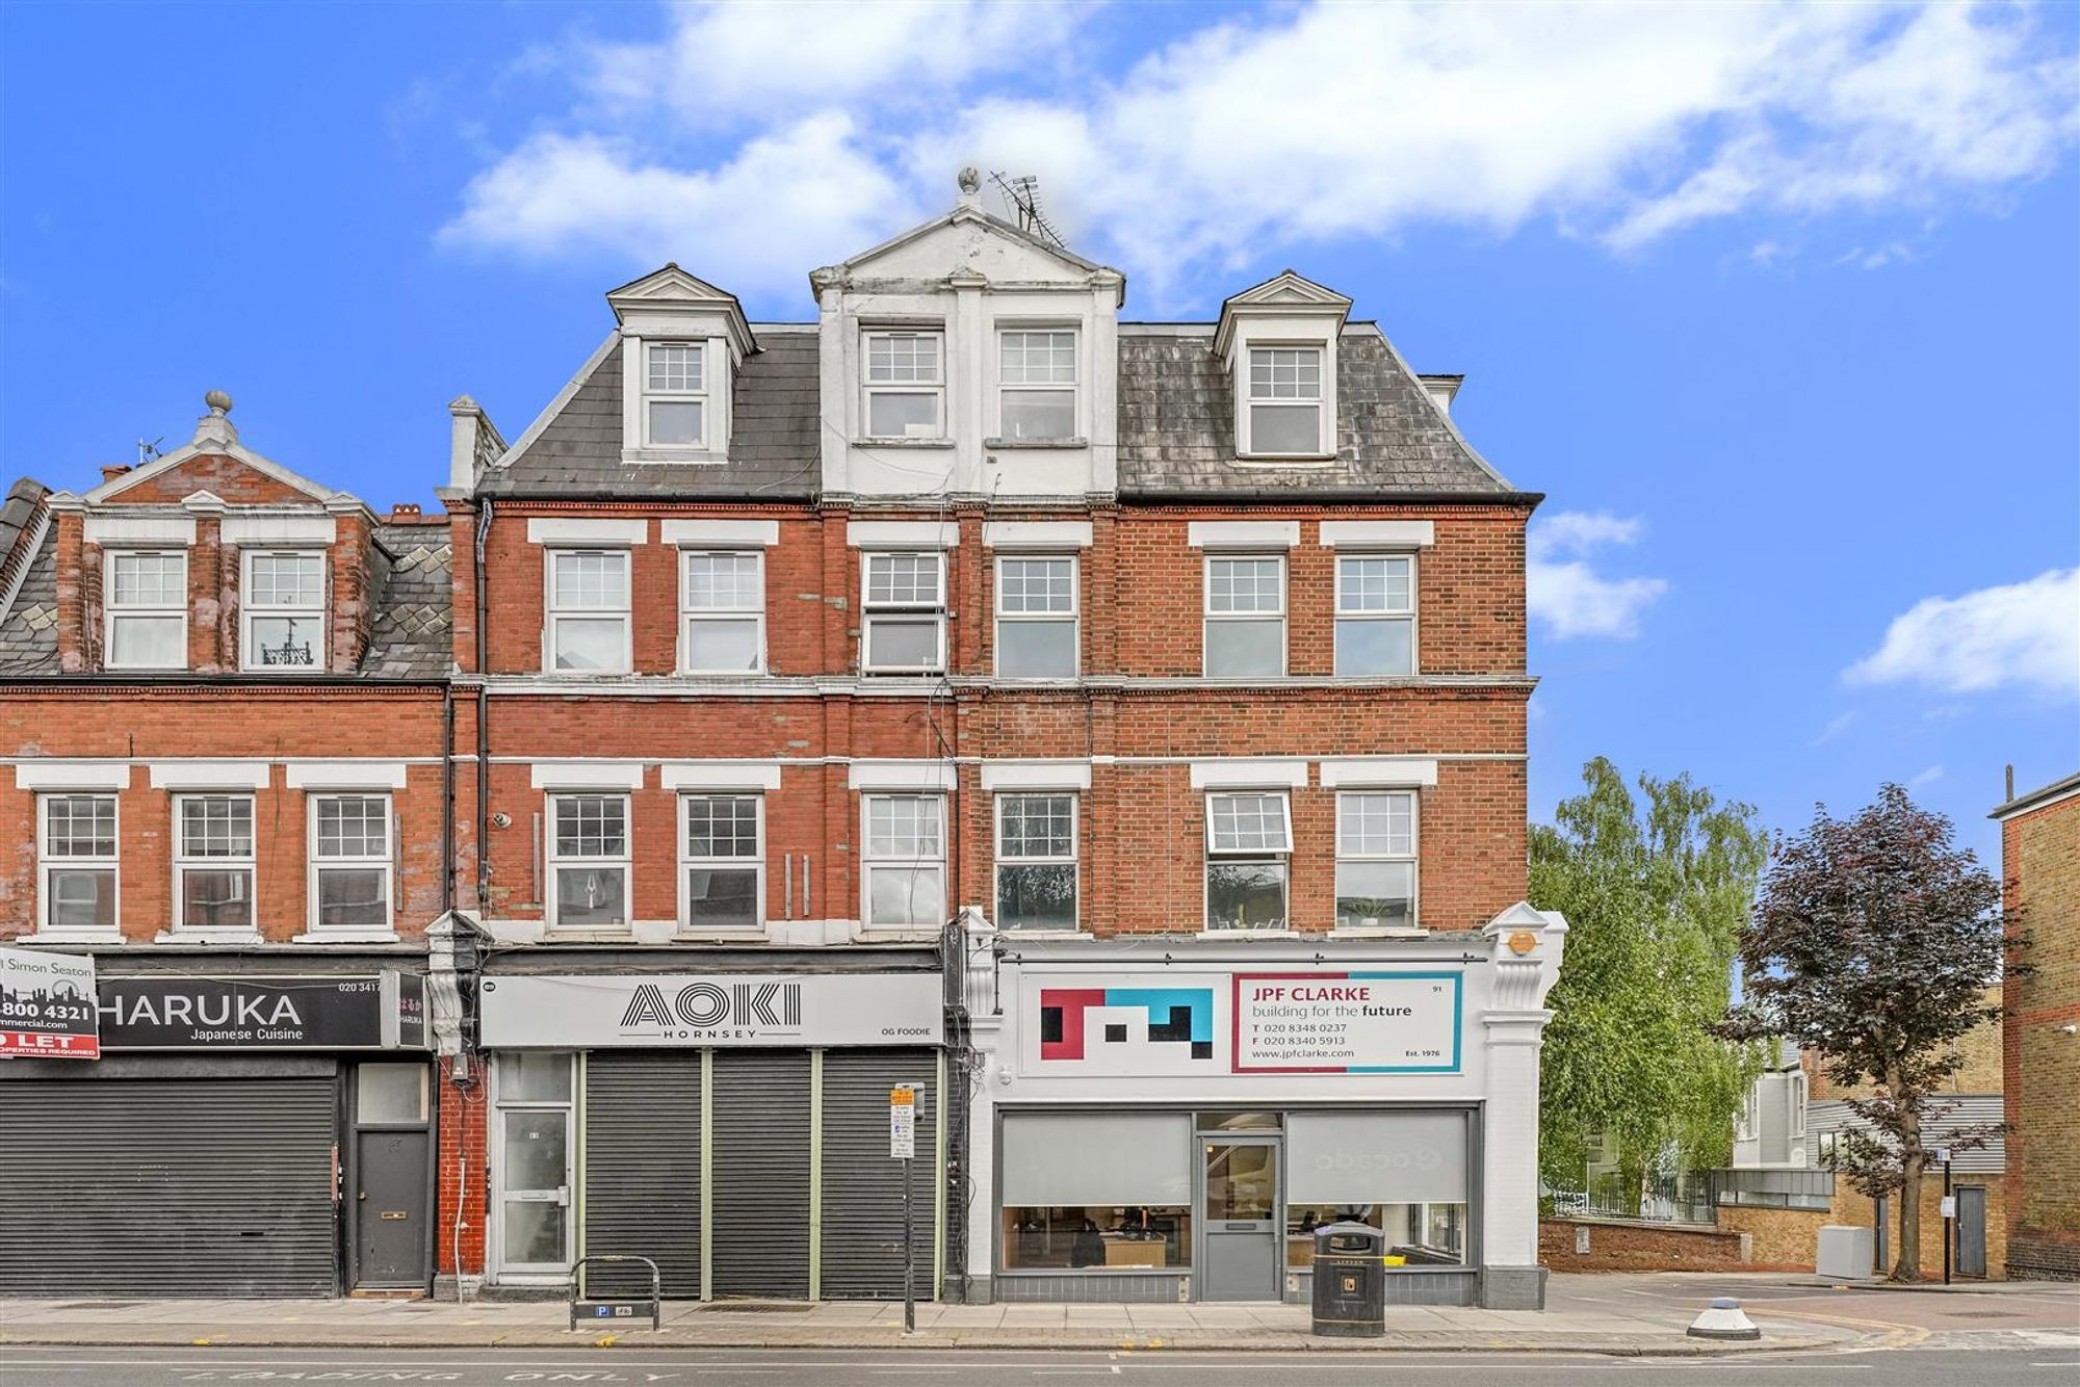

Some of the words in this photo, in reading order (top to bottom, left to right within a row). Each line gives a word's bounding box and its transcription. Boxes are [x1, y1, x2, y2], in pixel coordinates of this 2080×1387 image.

[8, 959, 47, 973] Simon
[51, 962, 92, 977] Seaton
[339, 982, 357, 992] 020
[1252, 988, 1285, 1001] JPF
[1291, 988, 1370, 1001] CLARKE
[96, 995, 302, 1026] HARUKA
[620, 982, 801, 1027] AOKI
[0, 1002, 39, 1017] 800
[44, 1005, 89, 1020] 4321
[1252, 1005, 1307, 1019] building
[1313, 1005, 1331, 1017] for
[1336, 1005, 1358, 1017] the
[1362, 1004, 1412, 1017] future
[897, 1027, 931, 1036] FOODIE
[1264, 1024, 1286, 1032] 020
[1288, 1024, 1317, 1032] 8348
[1319, 1024, 1347, 1032] 0237
[190, 1028, 251, 1042] Japanese
[257, 1028, 303, 1040] Cuisine
[664, 1030, 757, 1039] HORNSEY
[18, 1034, 74, 1048] LET
[1264, 1037, 1286, 1045] 020
[1288, 1037, 1317, 1045] 8340
[1319, 1037, 1346, 1045] 5913
[48, 1048, 96, 1056] REQUIRED
[1252, 1048, 1355, 1059] www.jpfclarke.com
[503, 1373, 681, 1381] ONLY
